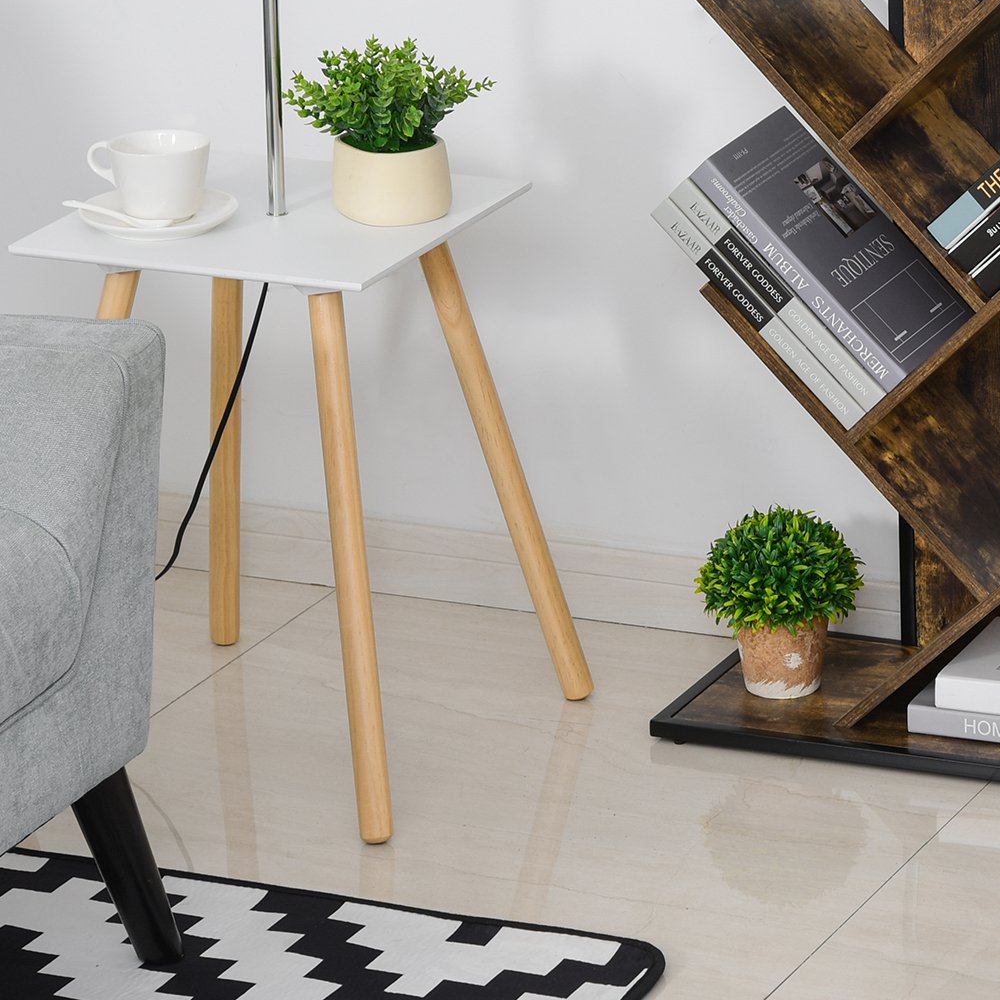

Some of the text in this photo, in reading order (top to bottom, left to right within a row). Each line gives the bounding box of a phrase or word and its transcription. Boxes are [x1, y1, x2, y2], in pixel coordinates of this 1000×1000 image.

[711, 178, 747, 217] Cloakrooms
[704, 258, 764, 323] FOREVER GODDESS
[723, 238, 783, 303] FOREVER GODDESS
[762, 242, 809, 290] ALBUM
[830, 233, 895, 288] SENTIQUE
[787, 308, 868, 396] GOLDEN AGE OF FASHION
[811, 295, 889, 380] MERCHANTS
[768, 328, 849, 416] GOLDEN AGE OF FASHION
